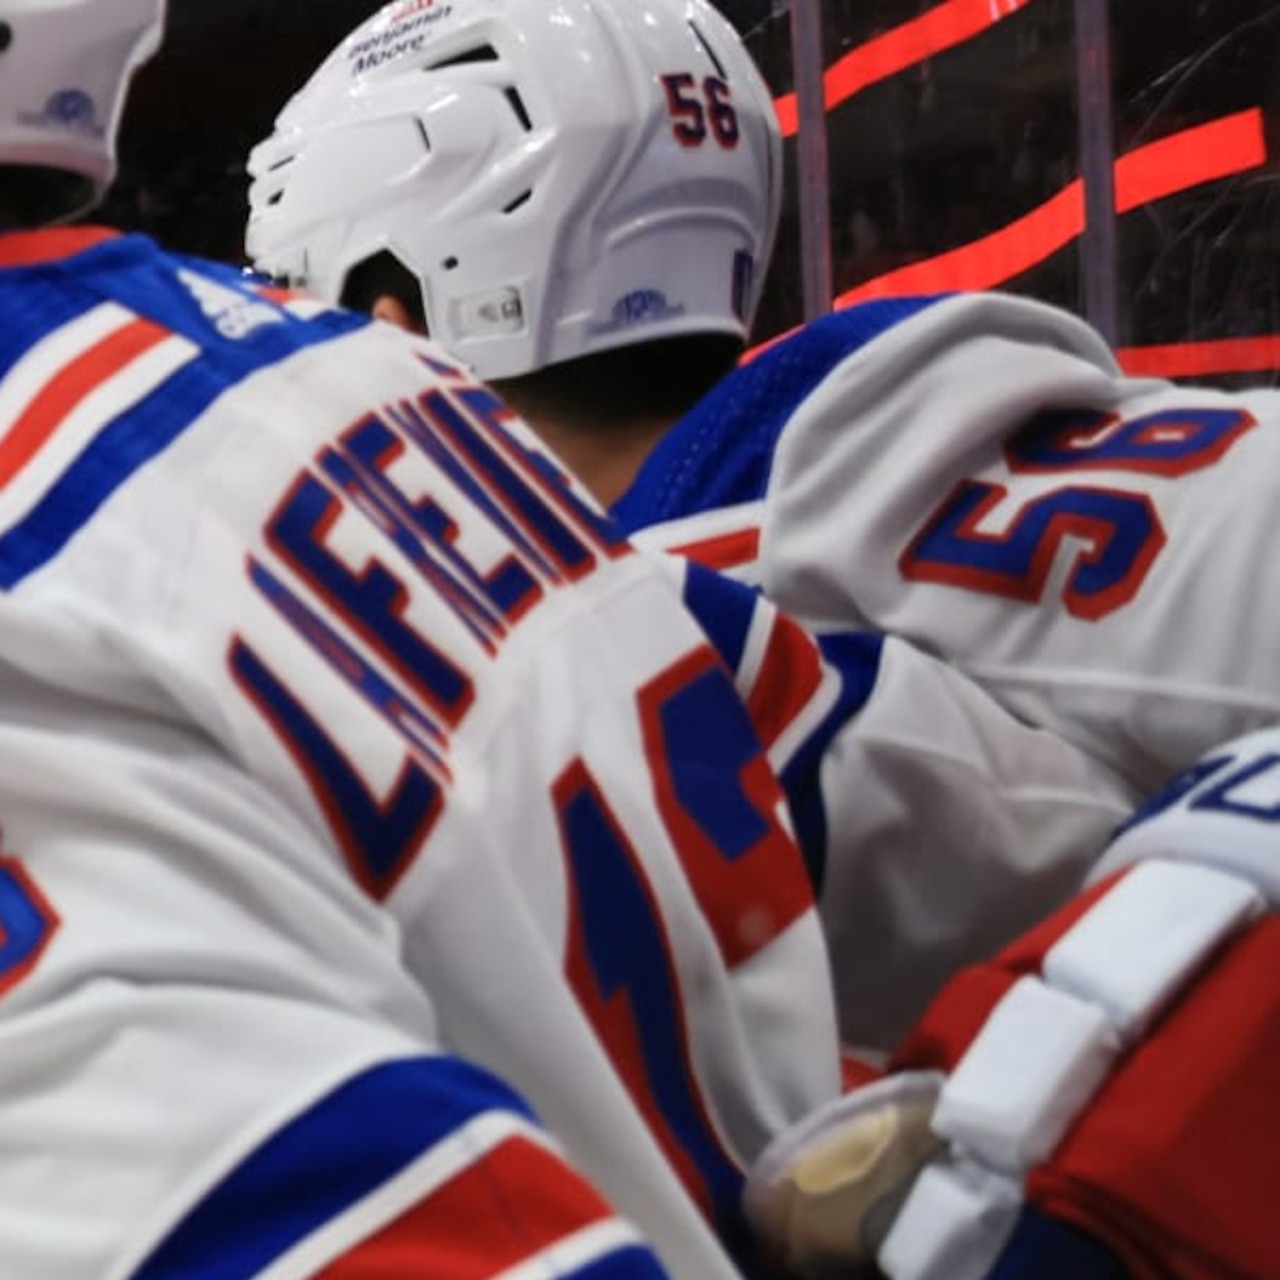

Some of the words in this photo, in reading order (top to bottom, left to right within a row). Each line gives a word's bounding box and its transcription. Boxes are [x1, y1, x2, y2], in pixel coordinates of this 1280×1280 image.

[351, 33, 426, 76] Moore
[662, 72, 740, 150] 56
[899, 407, 1260, 621] 56
